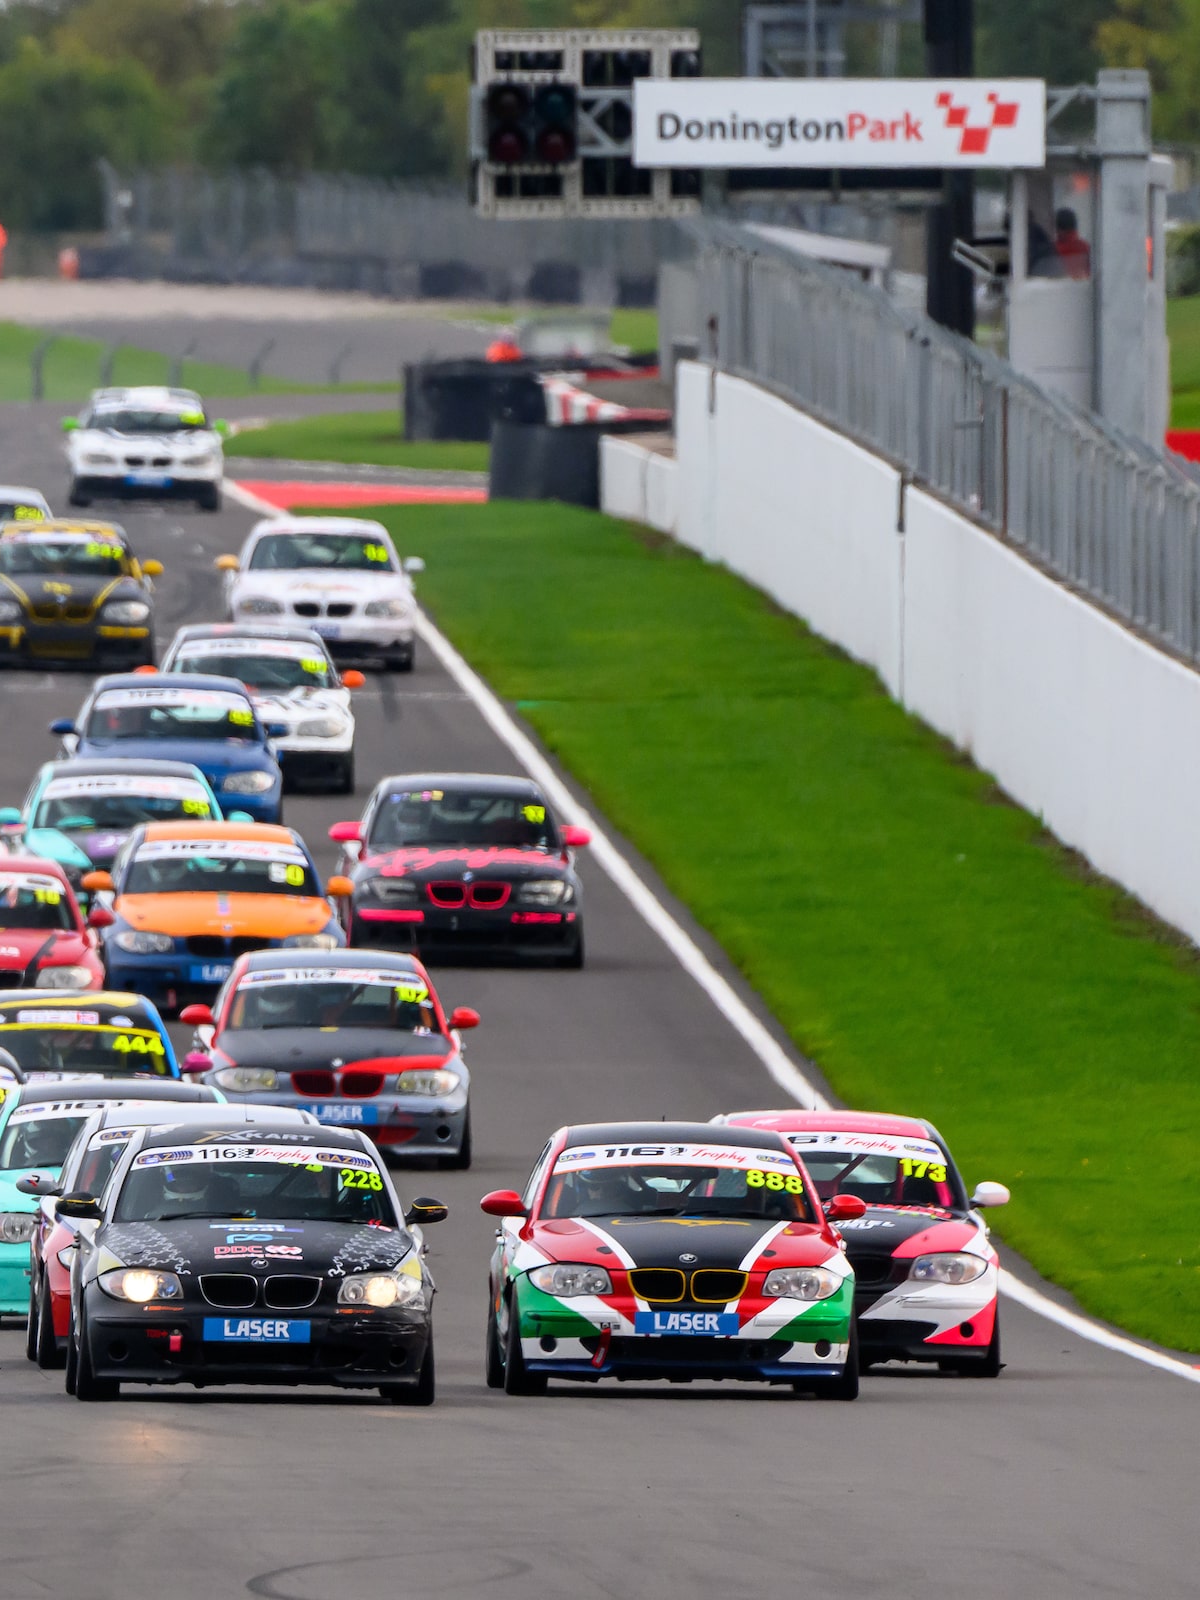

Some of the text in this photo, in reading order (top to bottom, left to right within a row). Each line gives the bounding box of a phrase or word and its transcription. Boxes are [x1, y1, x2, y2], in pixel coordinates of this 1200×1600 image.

[657, 110, 922, 149] DoningtonPark
[112, 1035, 165, 1056] 444
[845, 1137, 897, 1152] Trophy
[198, 1149, 236, 1160] 116
[254, 1148, 312, 1162] Trophy
[605, 1147, 665, 1158] 116
[691, 1148, 748, 1163] Trophy
[340, 1168, 384, 1191] 228
[900, 1157, 947, 1183] 173
[746, 1169, 804, 1194] 888
[214, 1245, 263, 1255] DDC
[224, 1319, 290, 1338] LASER
[654, 1313, 719, 1331] LASER
